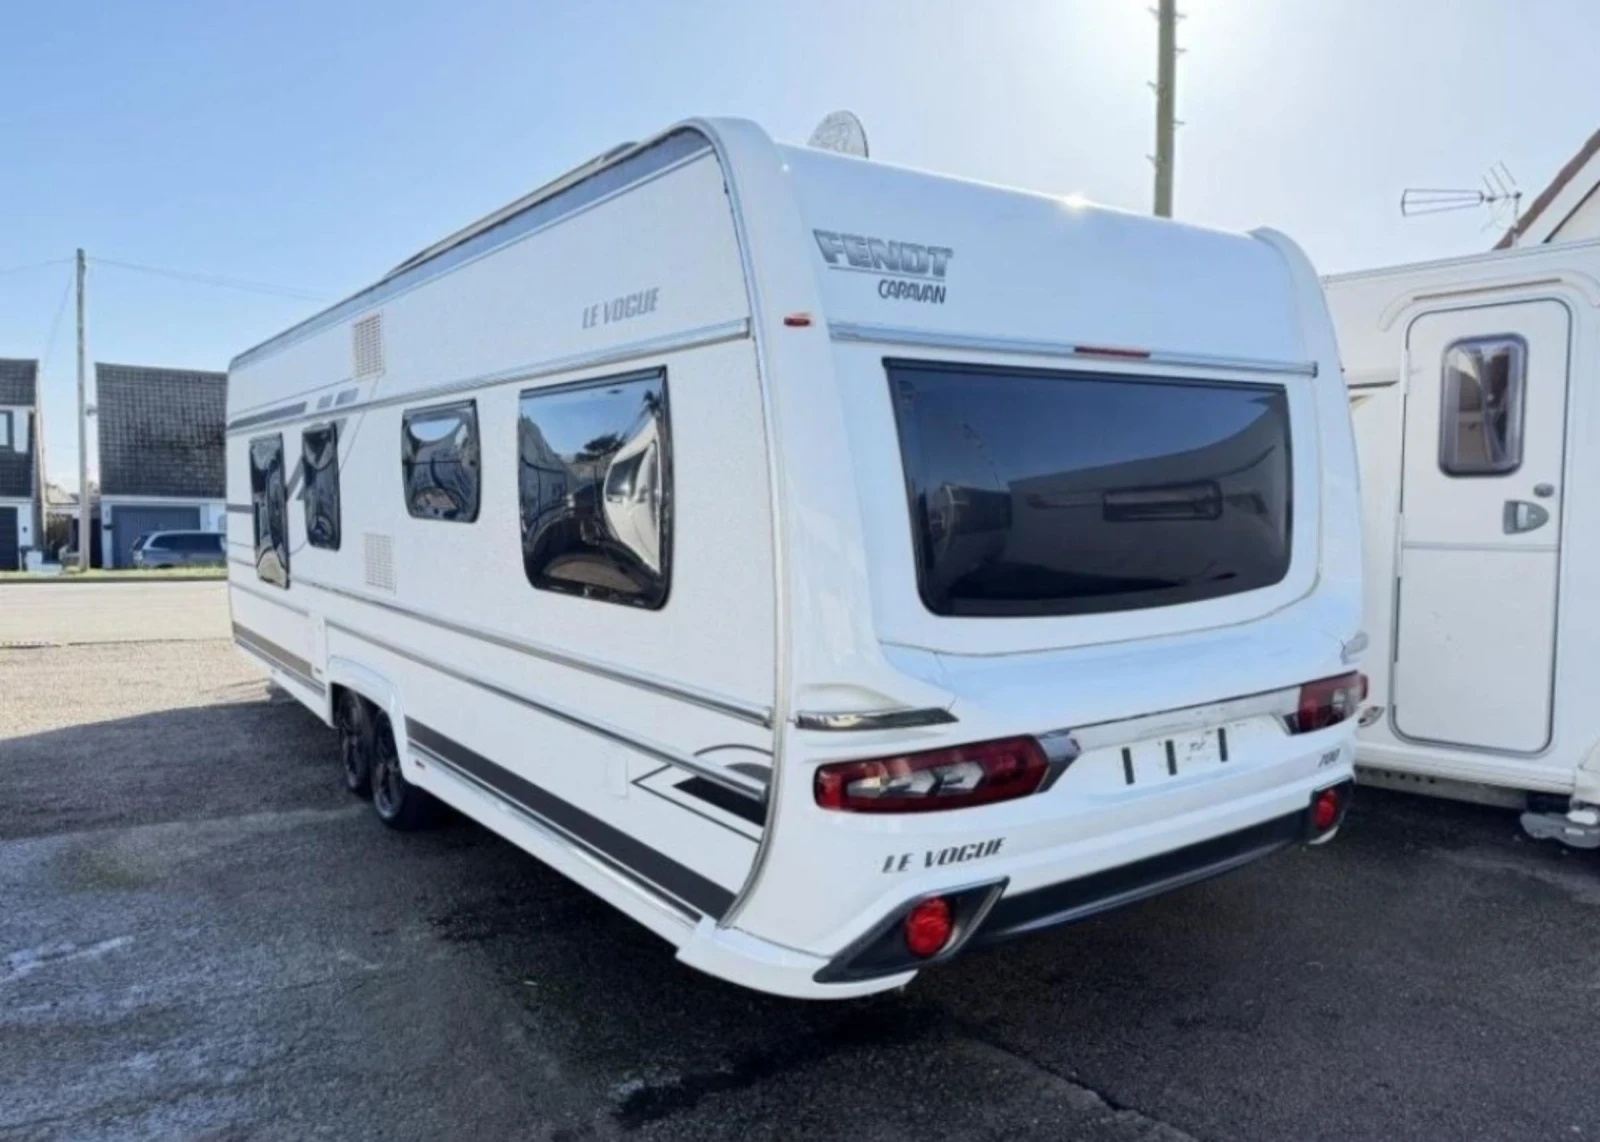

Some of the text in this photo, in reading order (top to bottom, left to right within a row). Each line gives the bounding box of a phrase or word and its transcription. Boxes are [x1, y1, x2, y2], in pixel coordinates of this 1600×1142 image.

[812, 228, 953, 277] FENDT
[582, 286, 660, 329] LE VOGUE
[878, 278, 947, 304] CARAVAN
[882, 837, 1006, 874] LE VOGUE
